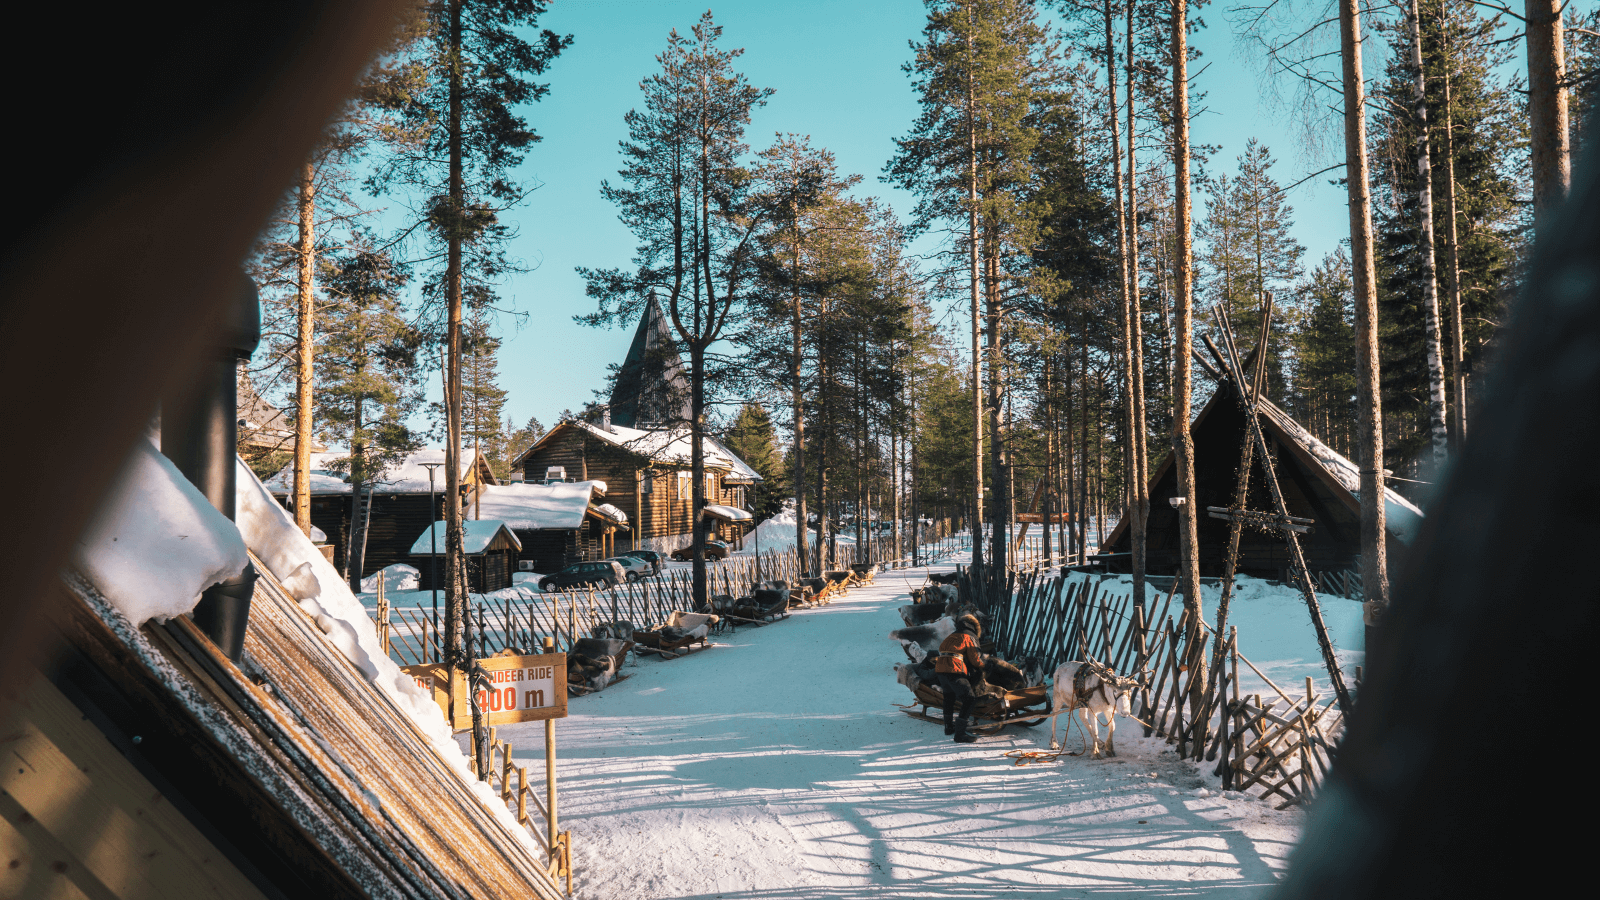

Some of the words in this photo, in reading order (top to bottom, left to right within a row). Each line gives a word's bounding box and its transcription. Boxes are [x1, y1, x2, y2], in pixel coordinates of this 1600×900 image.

[486, 669, 524, 684] NDEER
[528, 666, 552, 681] RIDE
[479, 687, 516, 713] 400
[525, 689, 544, 708] m
